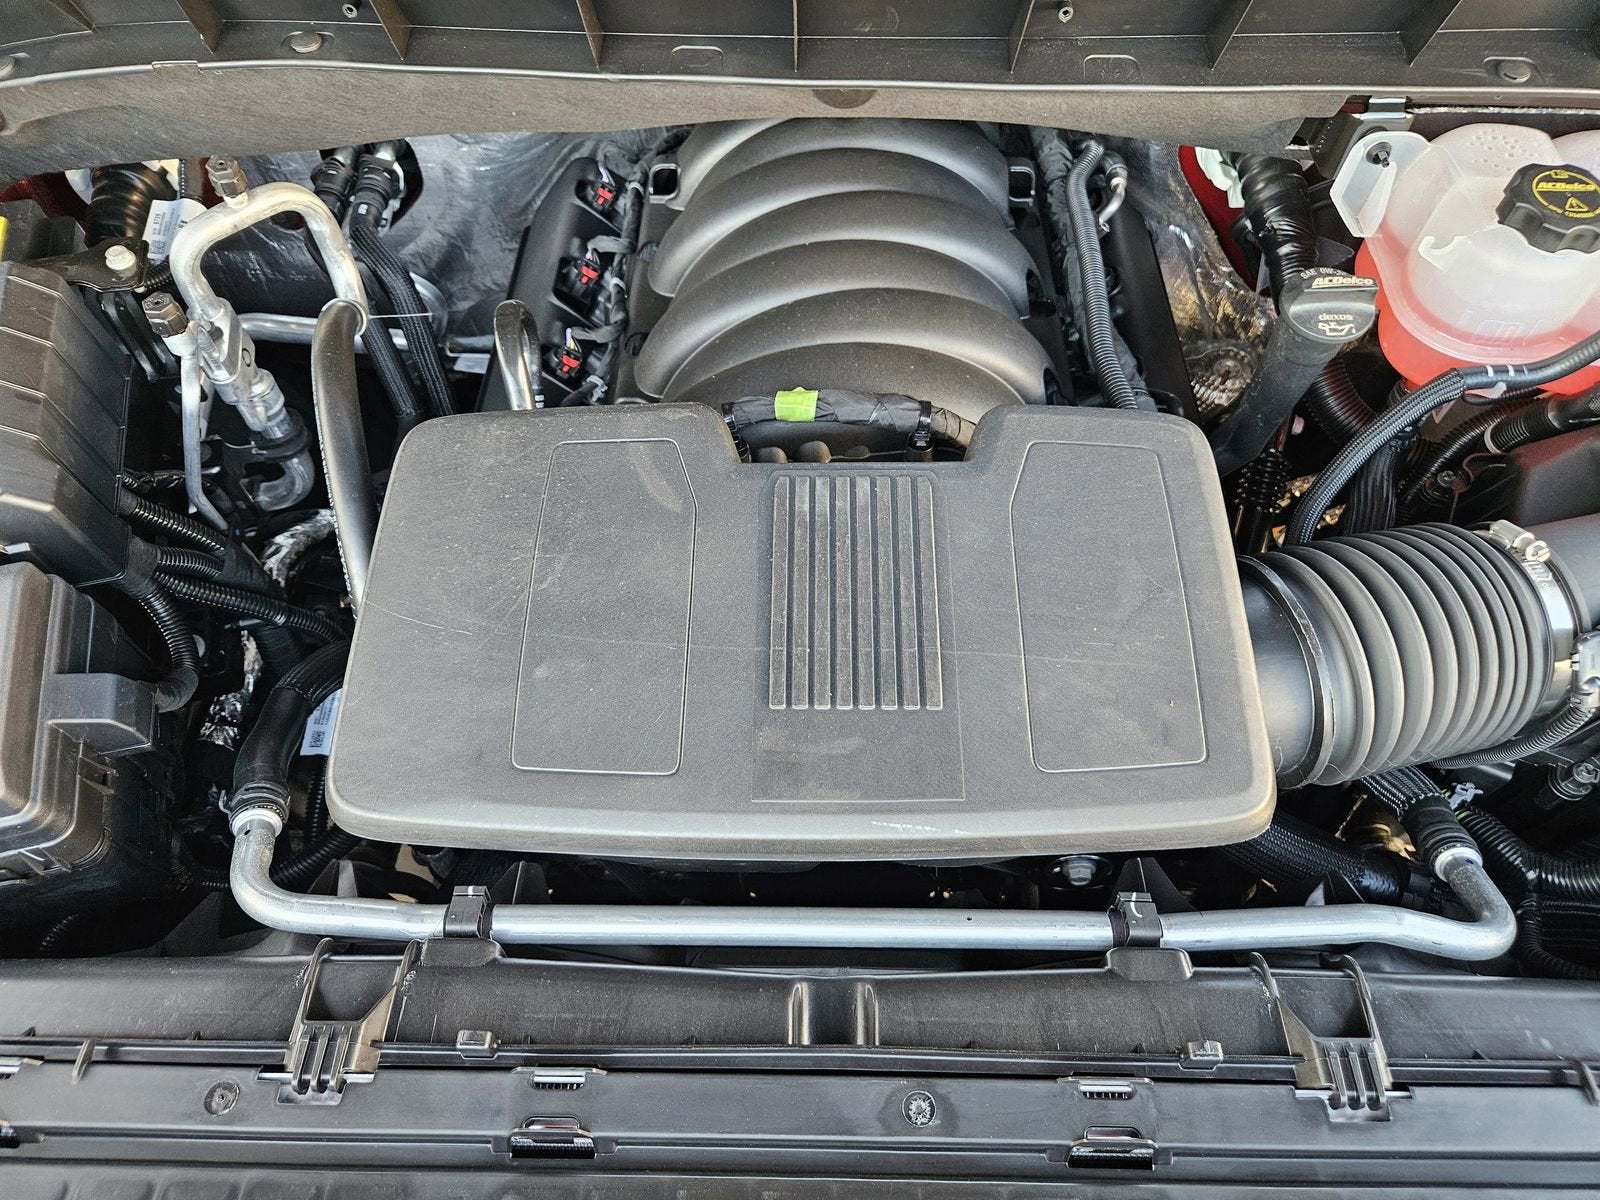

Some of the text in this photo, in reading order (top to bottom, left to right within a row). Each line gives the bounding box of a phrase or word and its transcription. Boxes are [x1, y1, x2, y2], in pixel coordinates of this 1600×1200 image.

[1537, 182, 1597, 190] ACDelco
[1300, 268, 1318, 279] SAE
[1312, 276, 1374, 287] ACDelco
[1318, 312, 1354, 320] dexos
